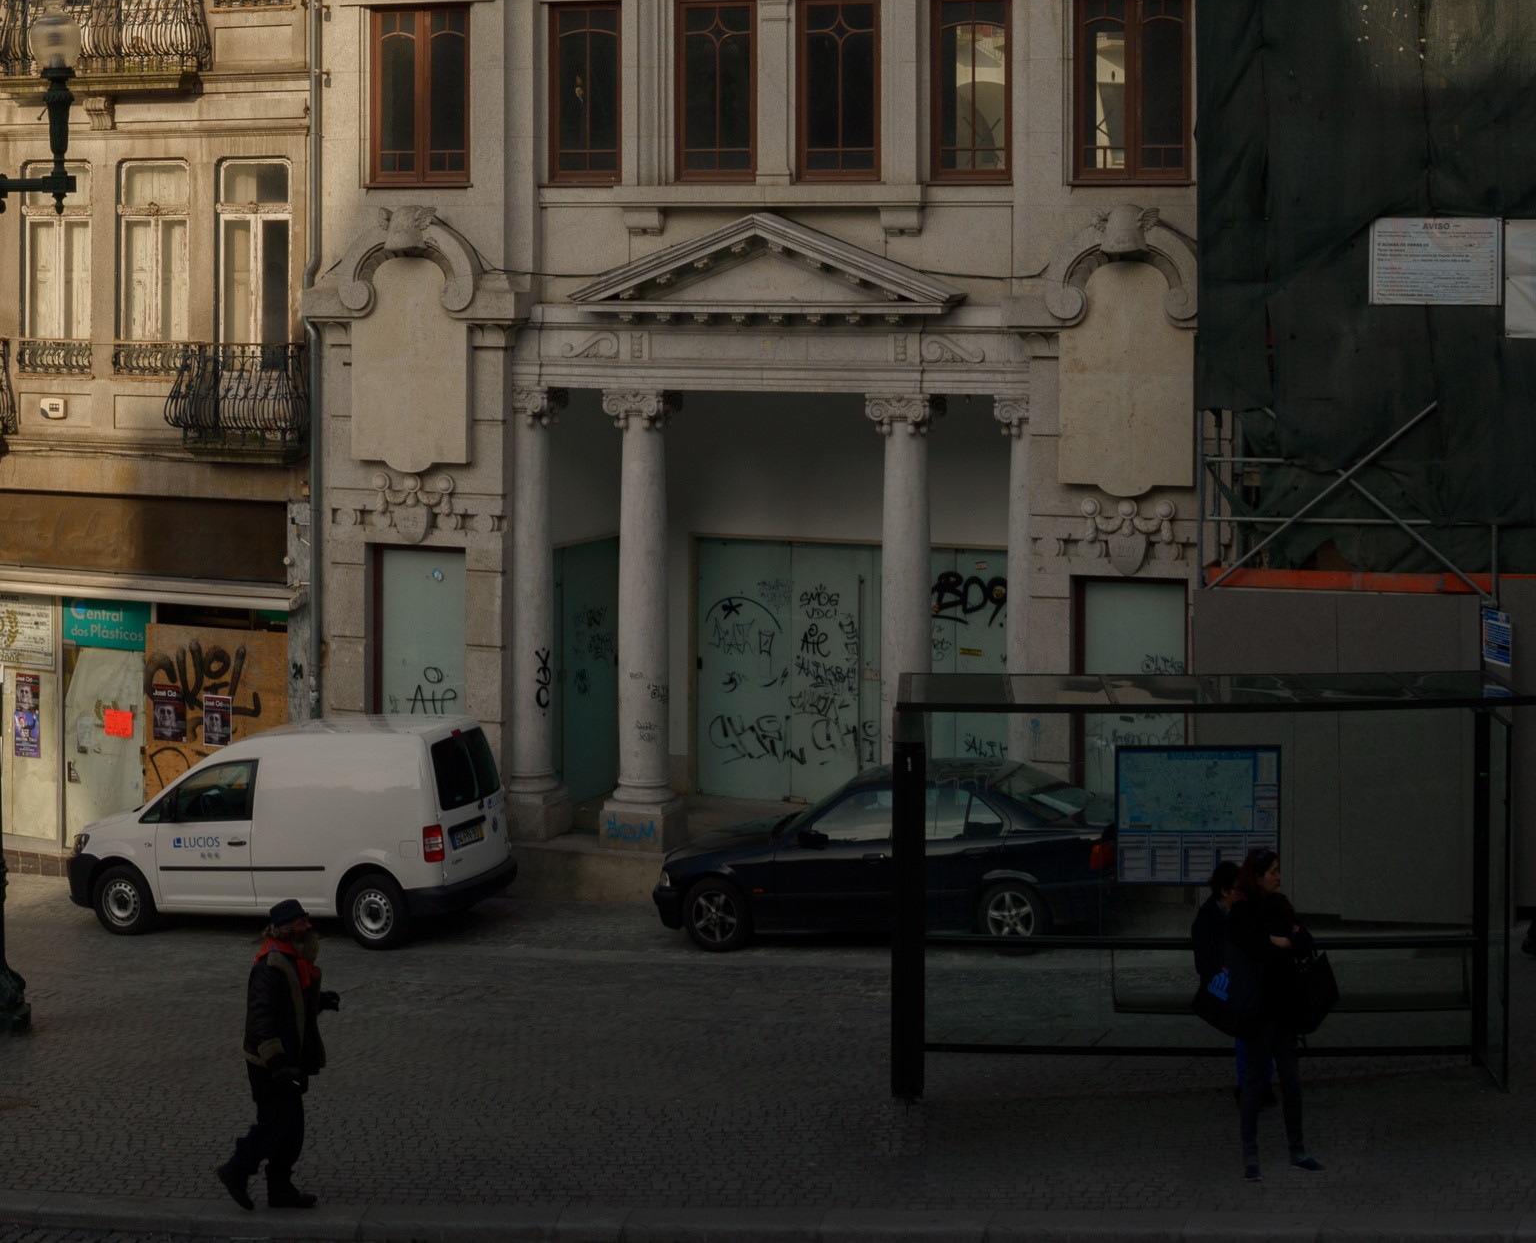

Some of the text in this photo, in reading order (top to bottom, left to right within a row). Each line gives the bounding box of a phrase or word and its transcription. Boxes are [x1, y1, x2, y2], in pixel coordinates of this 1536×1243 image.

[1422, 222, 1450, 230] AVISO
[70, 597, 123, 622] Central
[70, 624, 144, 643] dos Plásticos
[152, 688, 167, 696] José
[183, 836, 220, 848] LUCIOS
